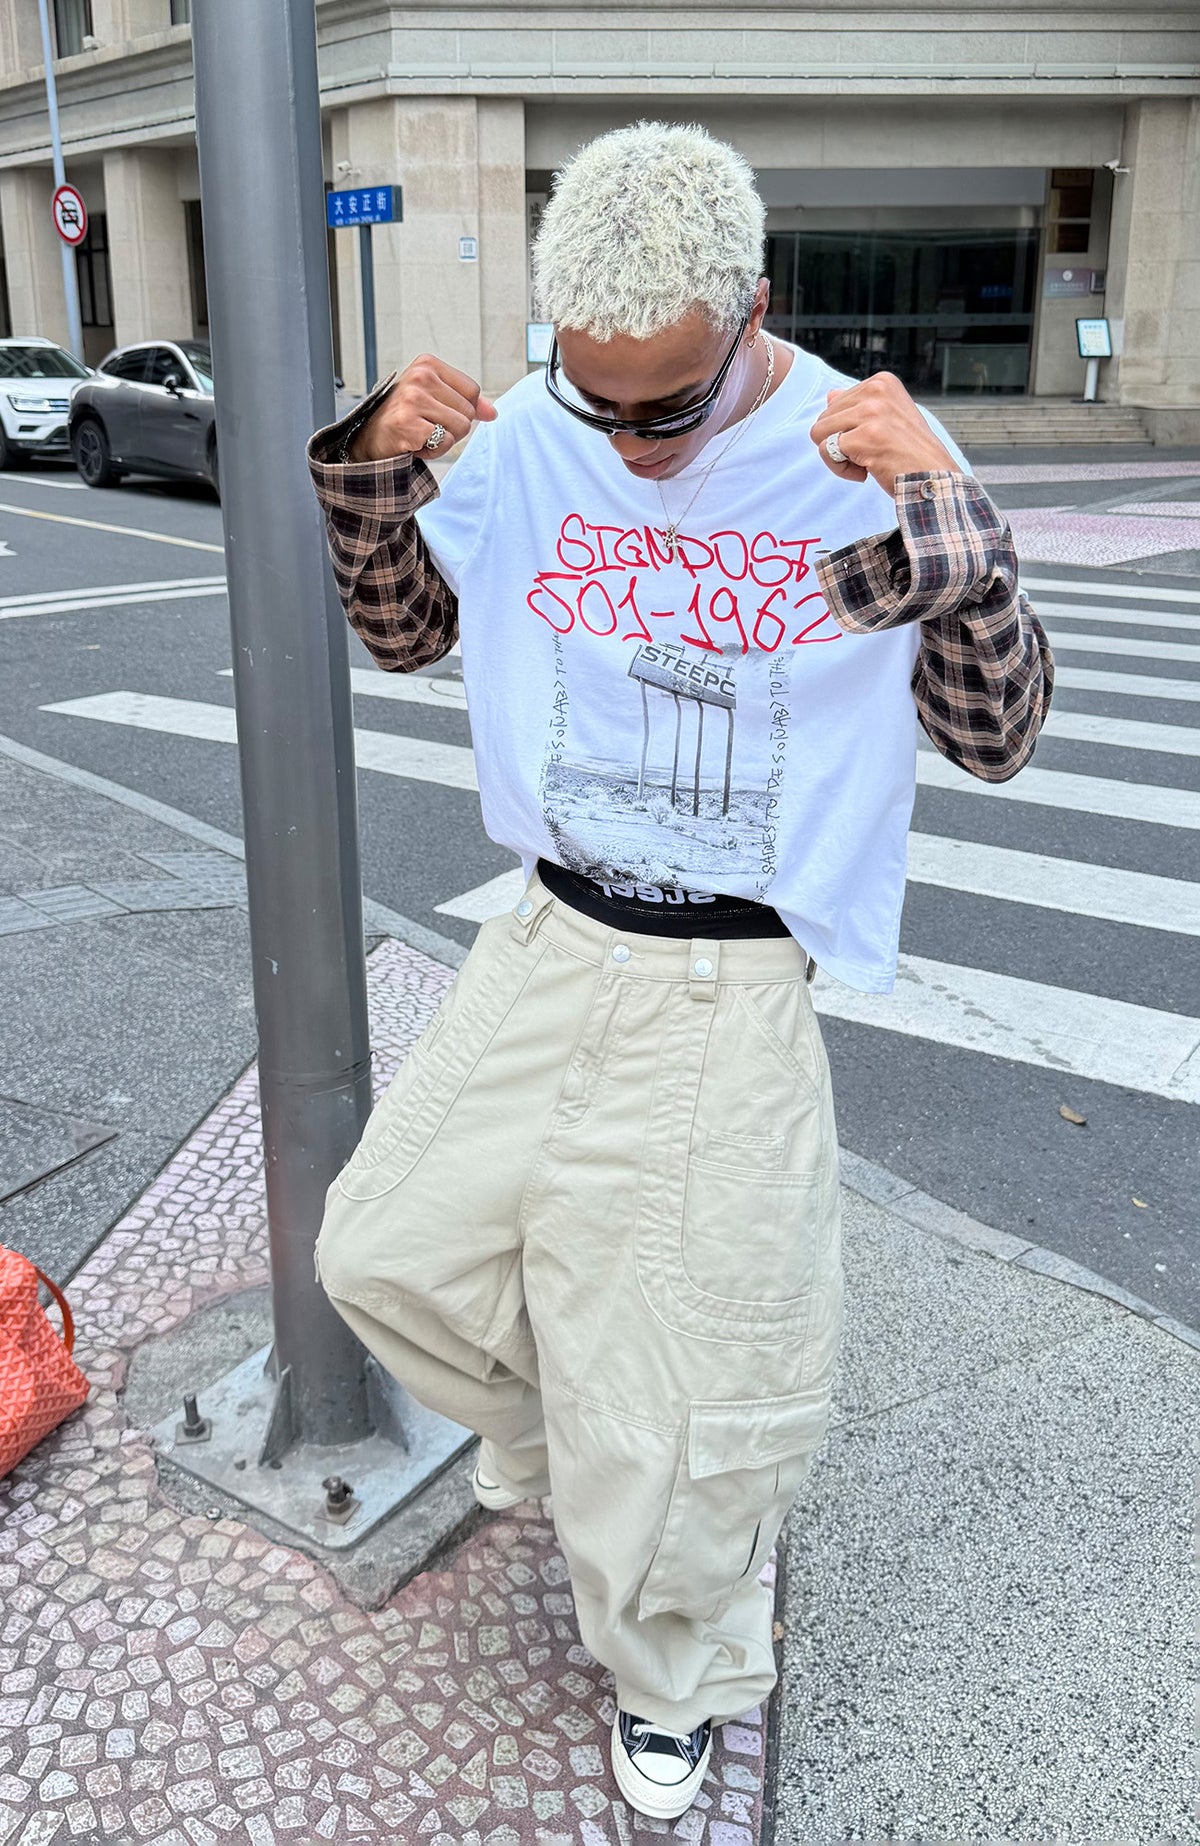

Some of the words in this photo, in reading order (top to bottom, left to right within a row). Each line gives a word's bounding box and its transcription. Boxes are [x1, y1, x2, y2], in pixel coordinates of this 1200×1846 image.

[334, 192, 387, 215] 大安正街
[557, 513, 821, 587] SIGNPOST
